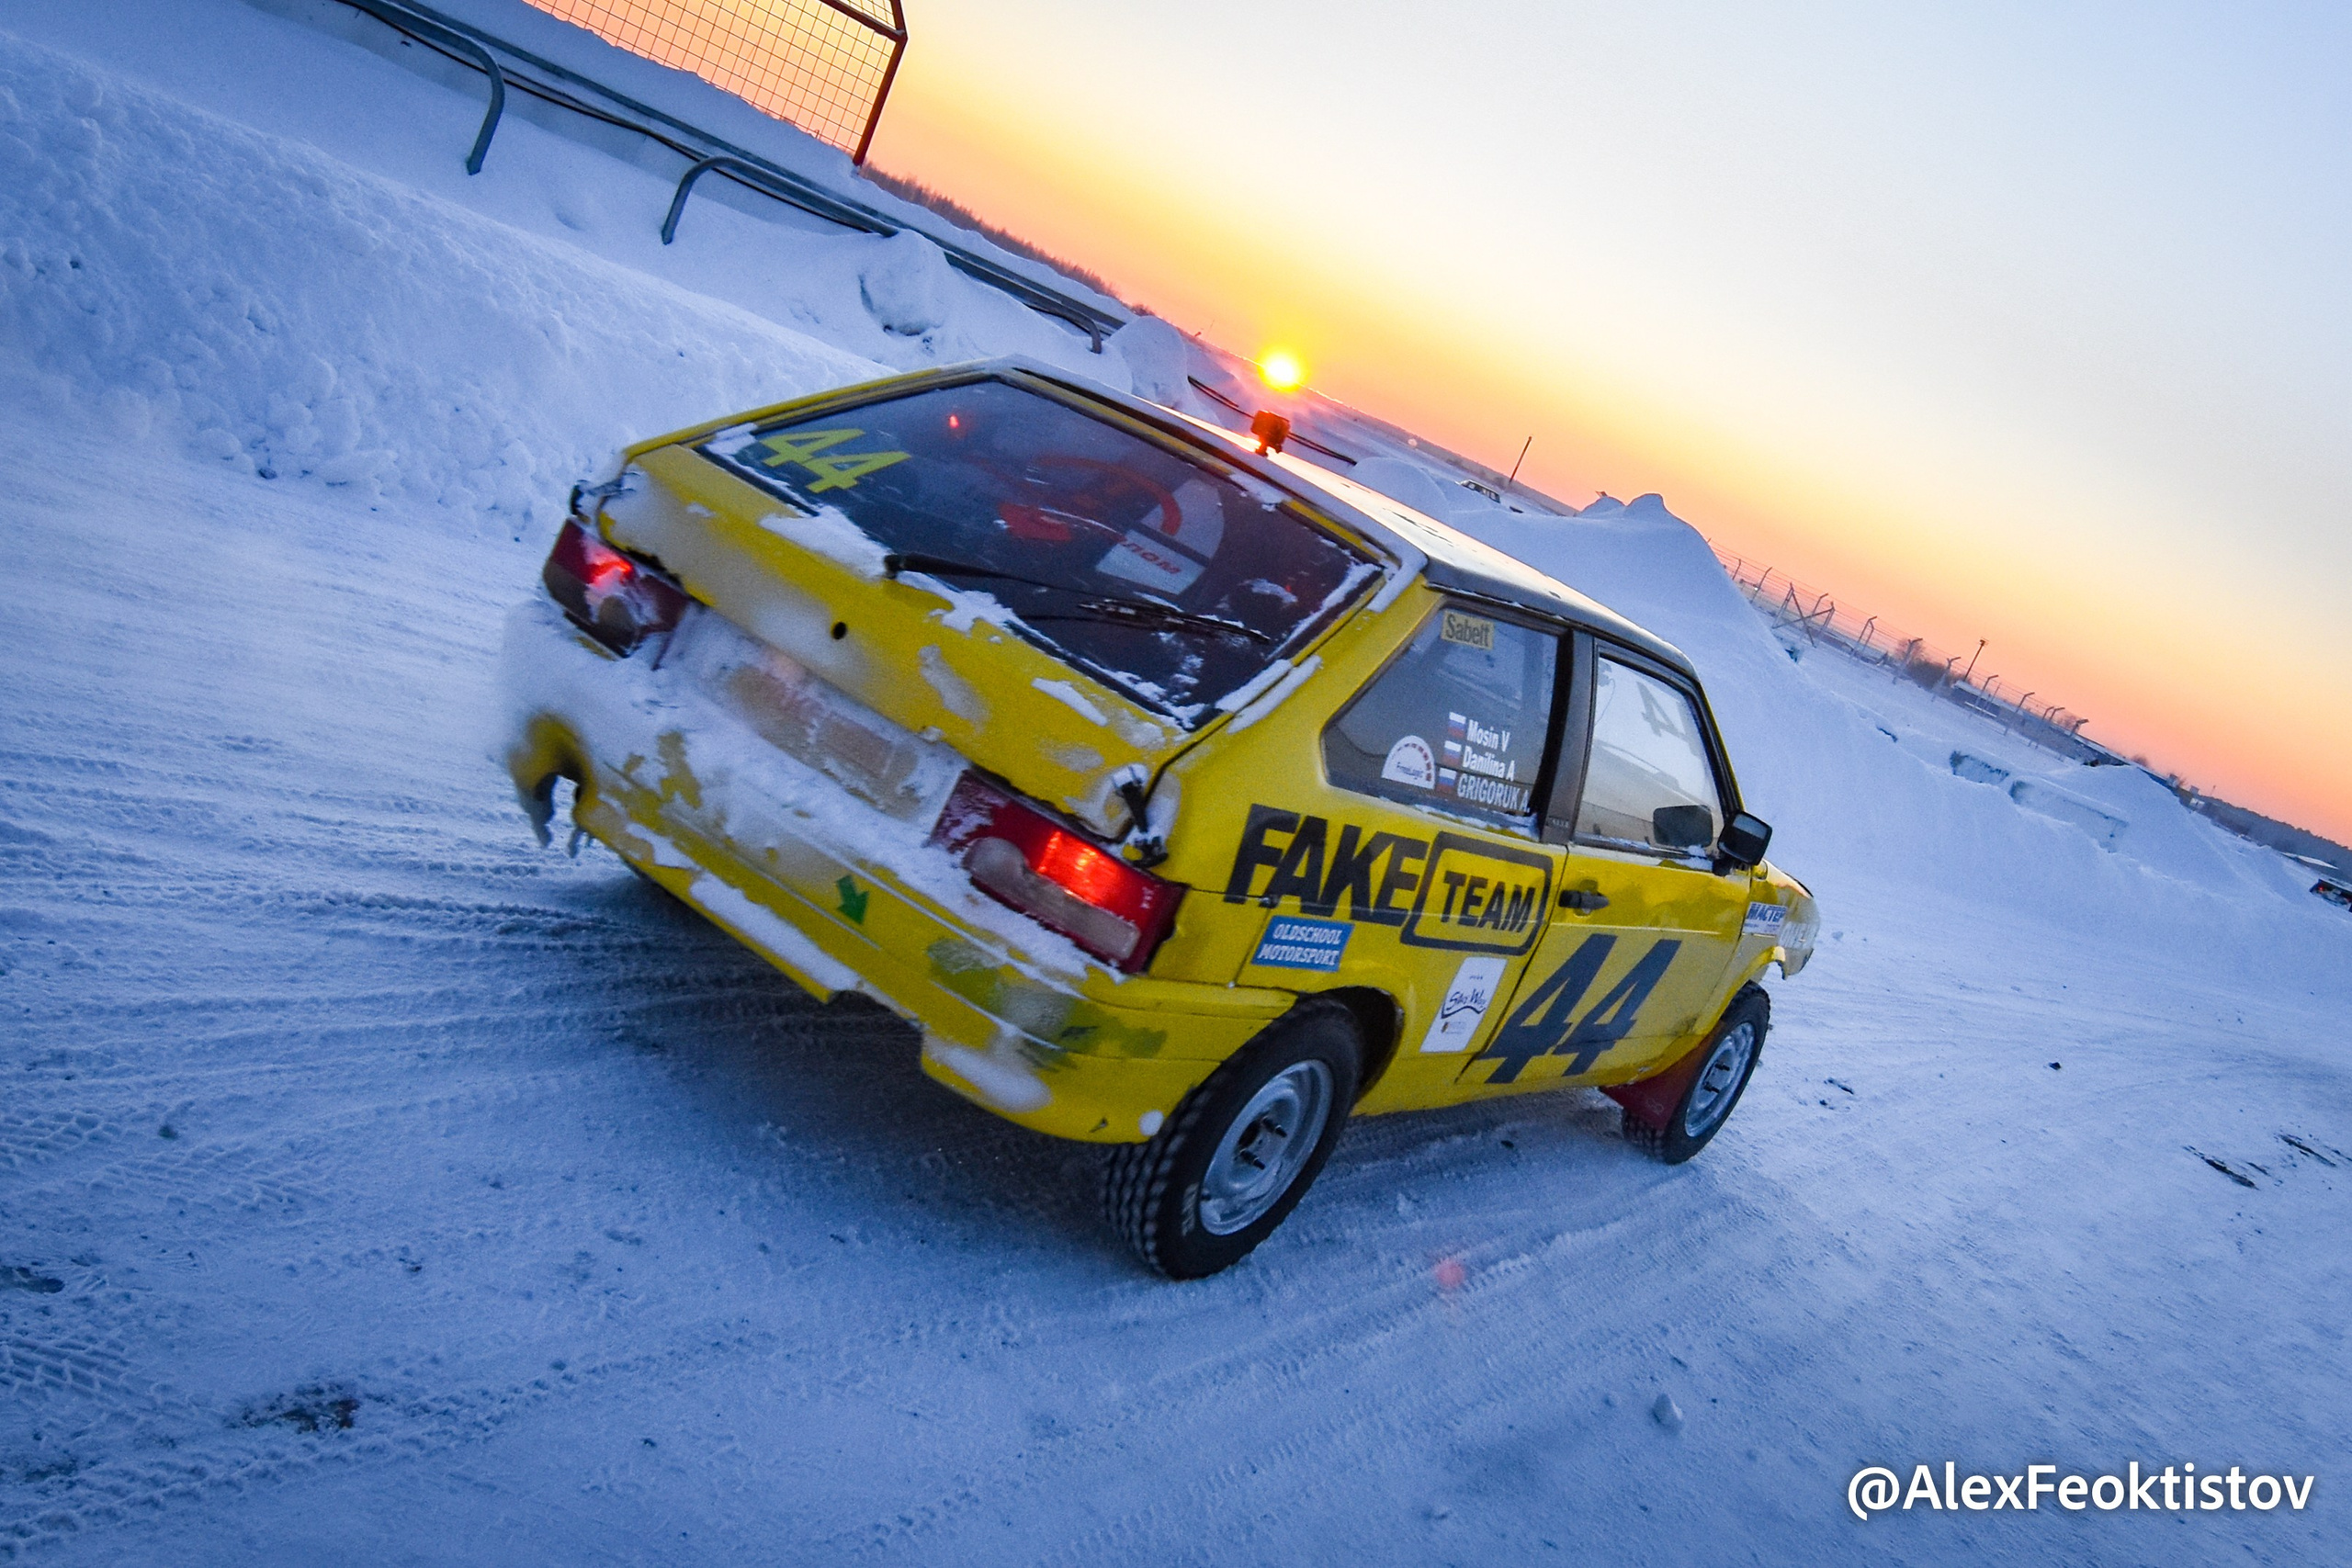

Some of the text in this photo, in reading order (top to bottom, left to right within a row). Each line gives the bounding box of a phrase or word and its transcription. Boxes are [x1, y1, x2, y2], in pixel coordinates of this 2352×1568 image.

[760, 428, 911, 493] 44
[1467, 719, 1510, 752] Mosin V
[1463, 745, 1515, 782] Danilina A
[1457, 773, 1521, 810] GRIGORUK
[1224, 804, 1430, 927] FAKE
[1442, 870, 1535, 933] TEAM
[1272, 923, 1342, 944] OLDSCHOOL
[1257, 943, 1340, 965] MOTORSPORT
[1476, 933, 1682, 1084] 44
